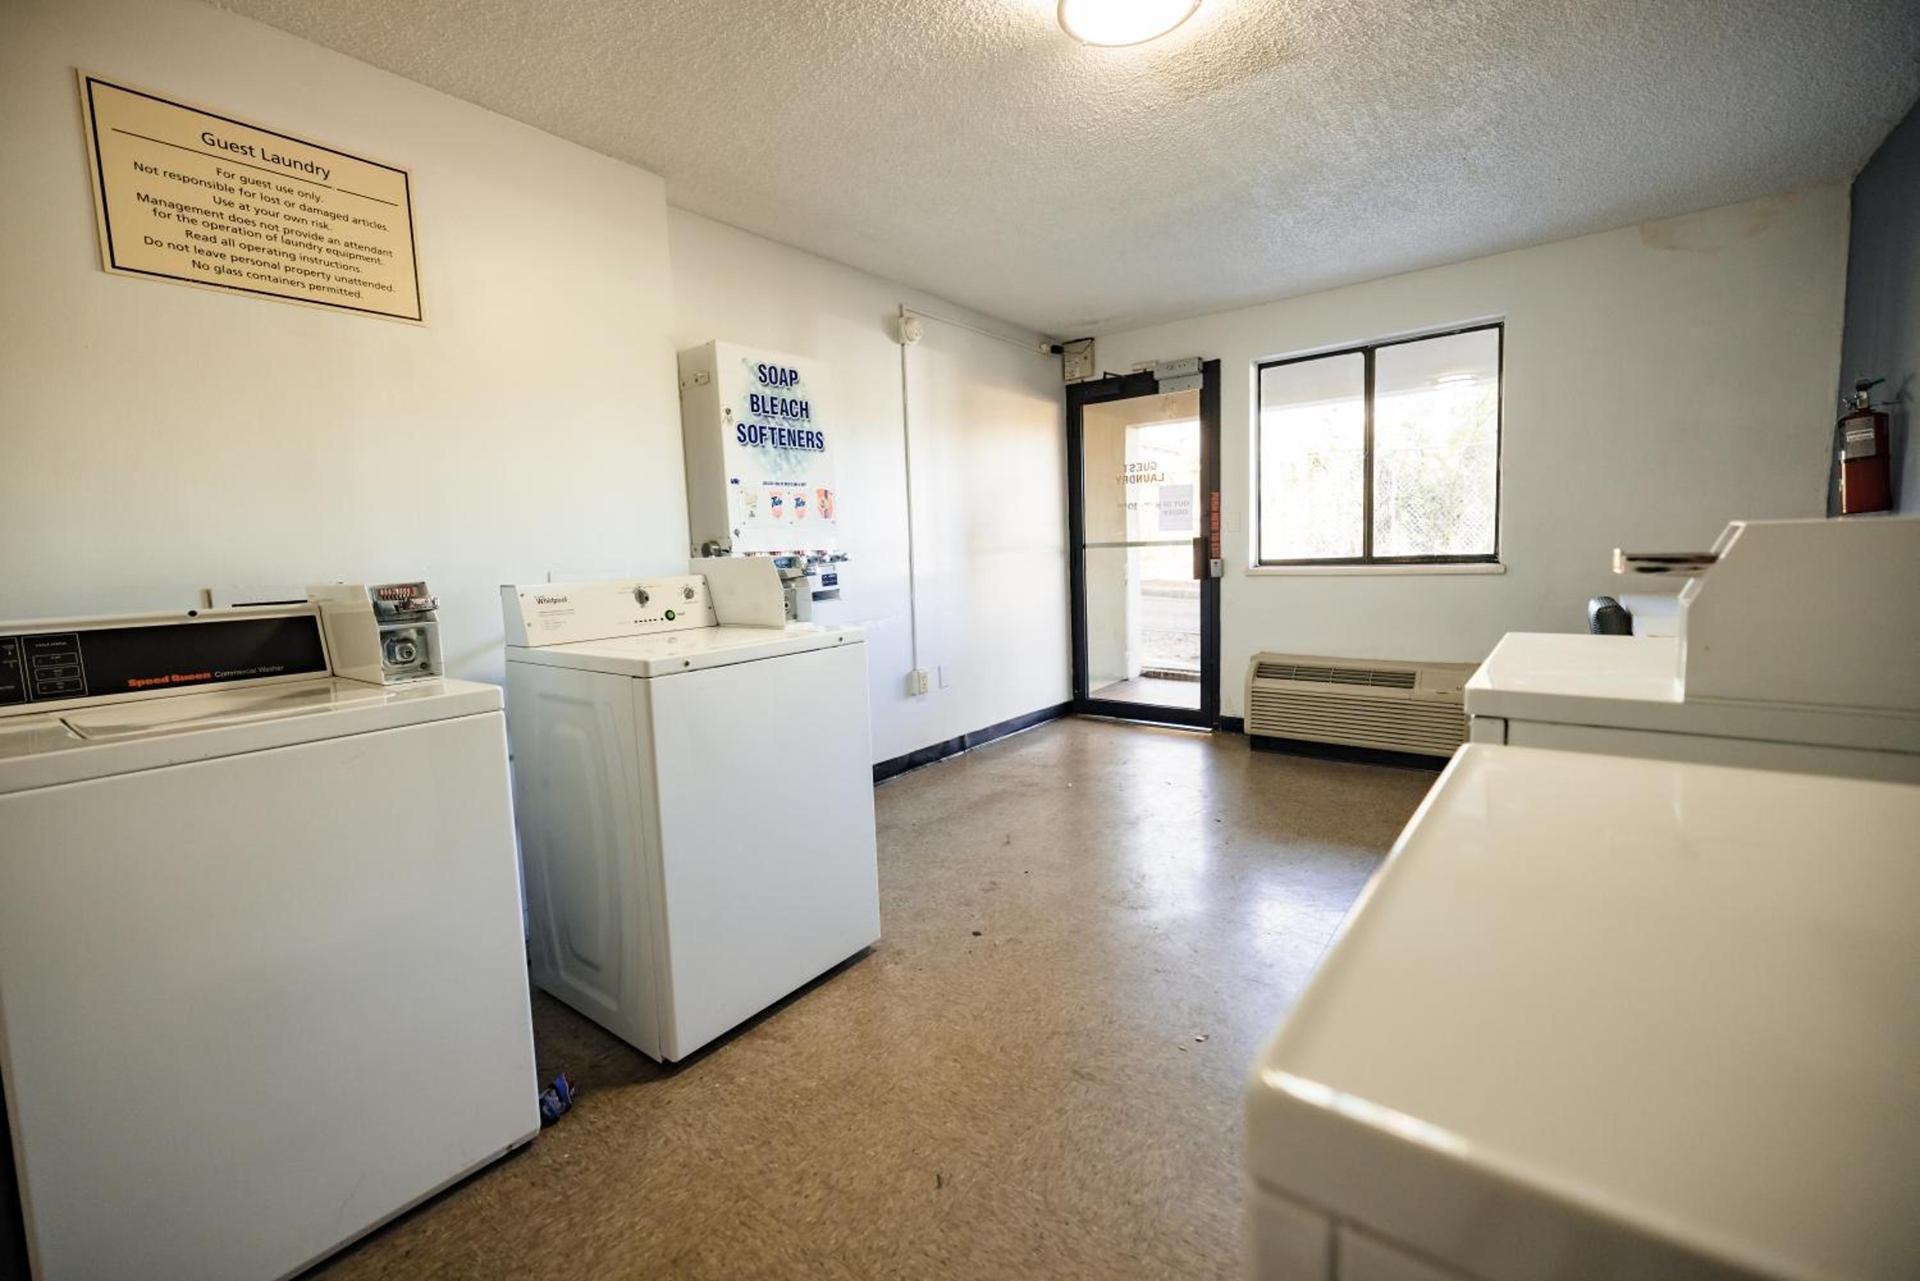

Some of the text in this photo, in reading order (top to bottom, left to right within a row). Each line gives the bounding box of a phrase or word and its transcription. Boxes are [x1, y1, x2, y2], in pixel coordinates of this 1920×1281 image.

[201, 132, 330, 180] Guest Laundry
[133, 161, 390, 232] Not responsible for lost or damaged articles.
[216, 167, 324, 203] For guest use only.
[136, 192, 393, 257] Management does not provide an attendant
[213, 195, 333, 230] Use at your own risk.
[152, 207, 384, 265] for the operation of laundry equipment.
[184, 229, 362, 273] Read all operating instructions.
[143, 235, 396, 292] Do not leave personal property unattended.
[191, 259, 364, 299] No glass containers permitted.
[758, 363, 800, 388] SOAP
[749, 393, 810, 420] BLEACH
[736, 422, 826, 452] SOFTENERS
[127, 674, 170, 688] Speed
[171, 671, 212, 683] Queen
